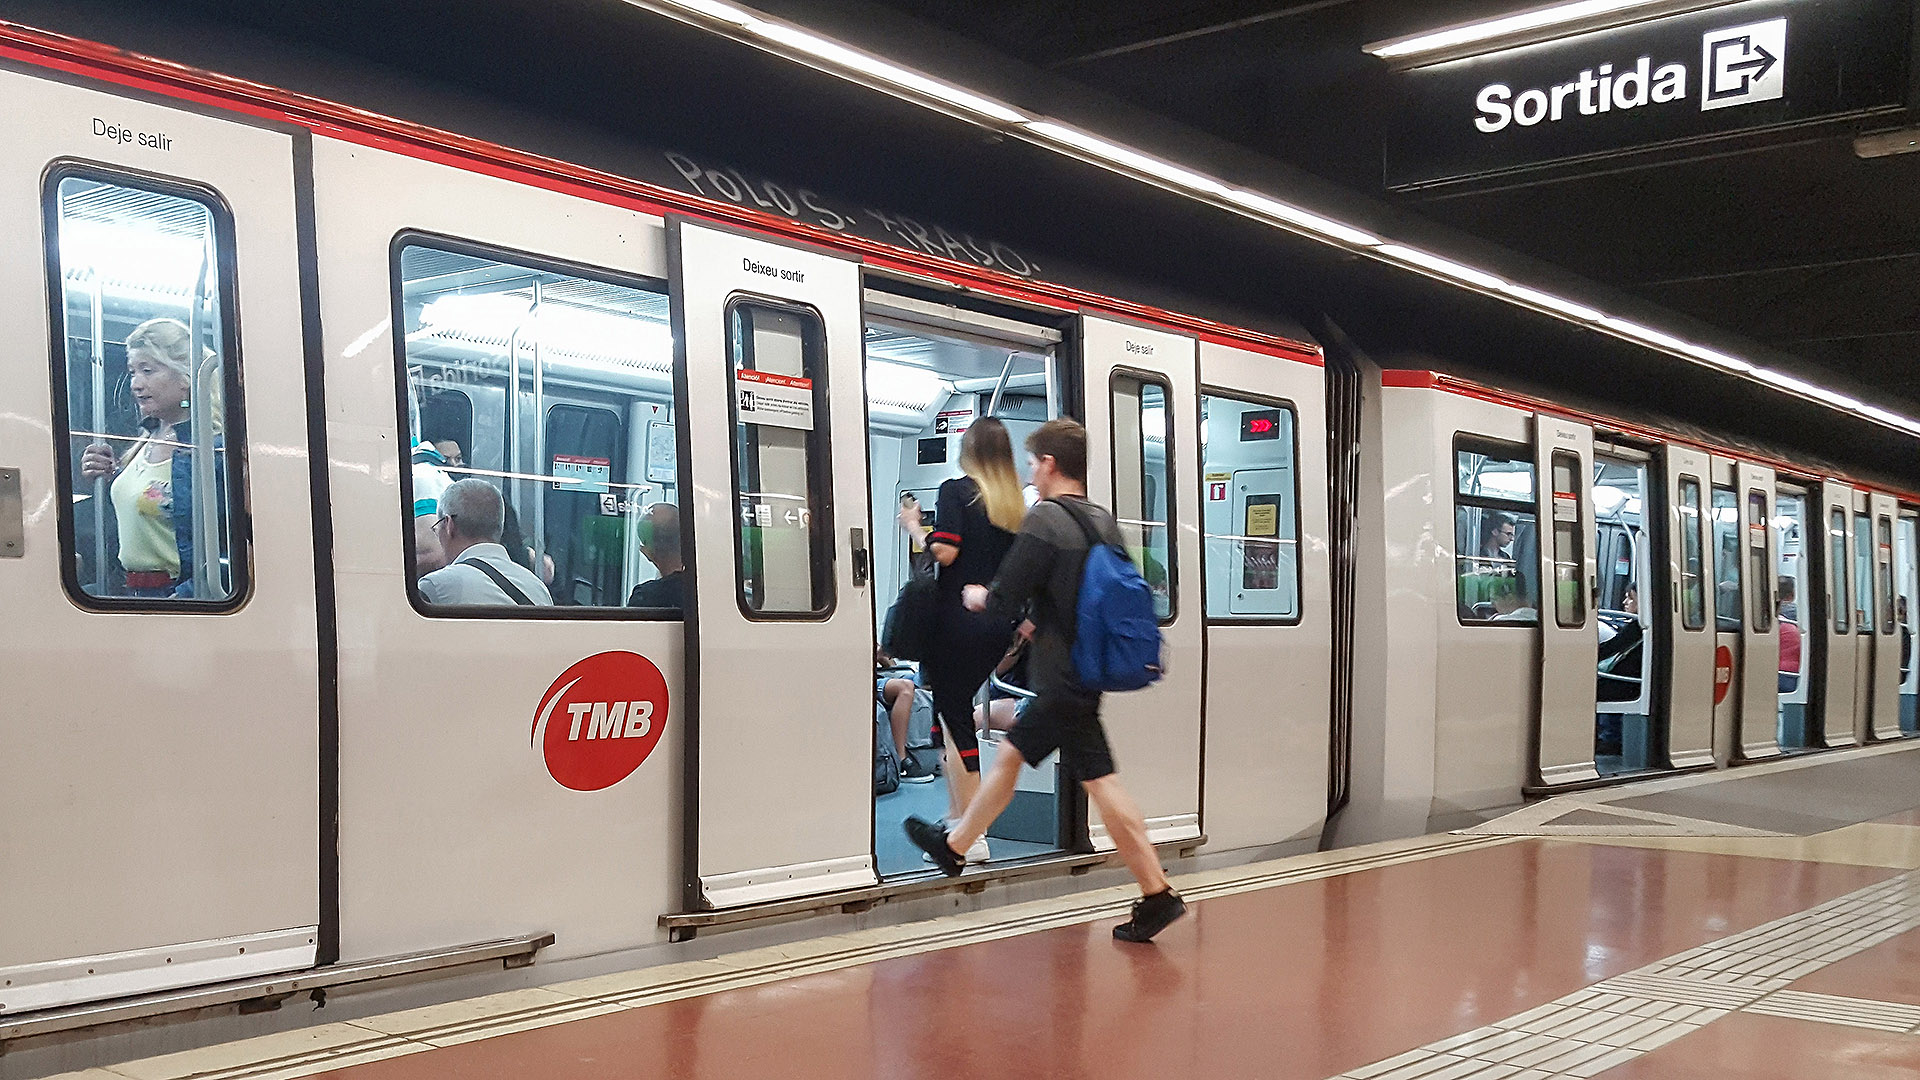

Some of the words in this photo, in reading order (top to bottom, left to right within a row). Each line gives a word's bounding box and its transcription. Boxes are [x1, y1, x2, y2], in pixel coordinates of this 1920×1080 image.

[1474, 56, 1687, 133] Sortida
[93, 117, 132, 144] Deje
[138, 132, 173, 151] salir
[743, 257, 778, 278] Deixeu
[780, 269, 805, 283] sortir
[567, 700, 654, 741] TMB
